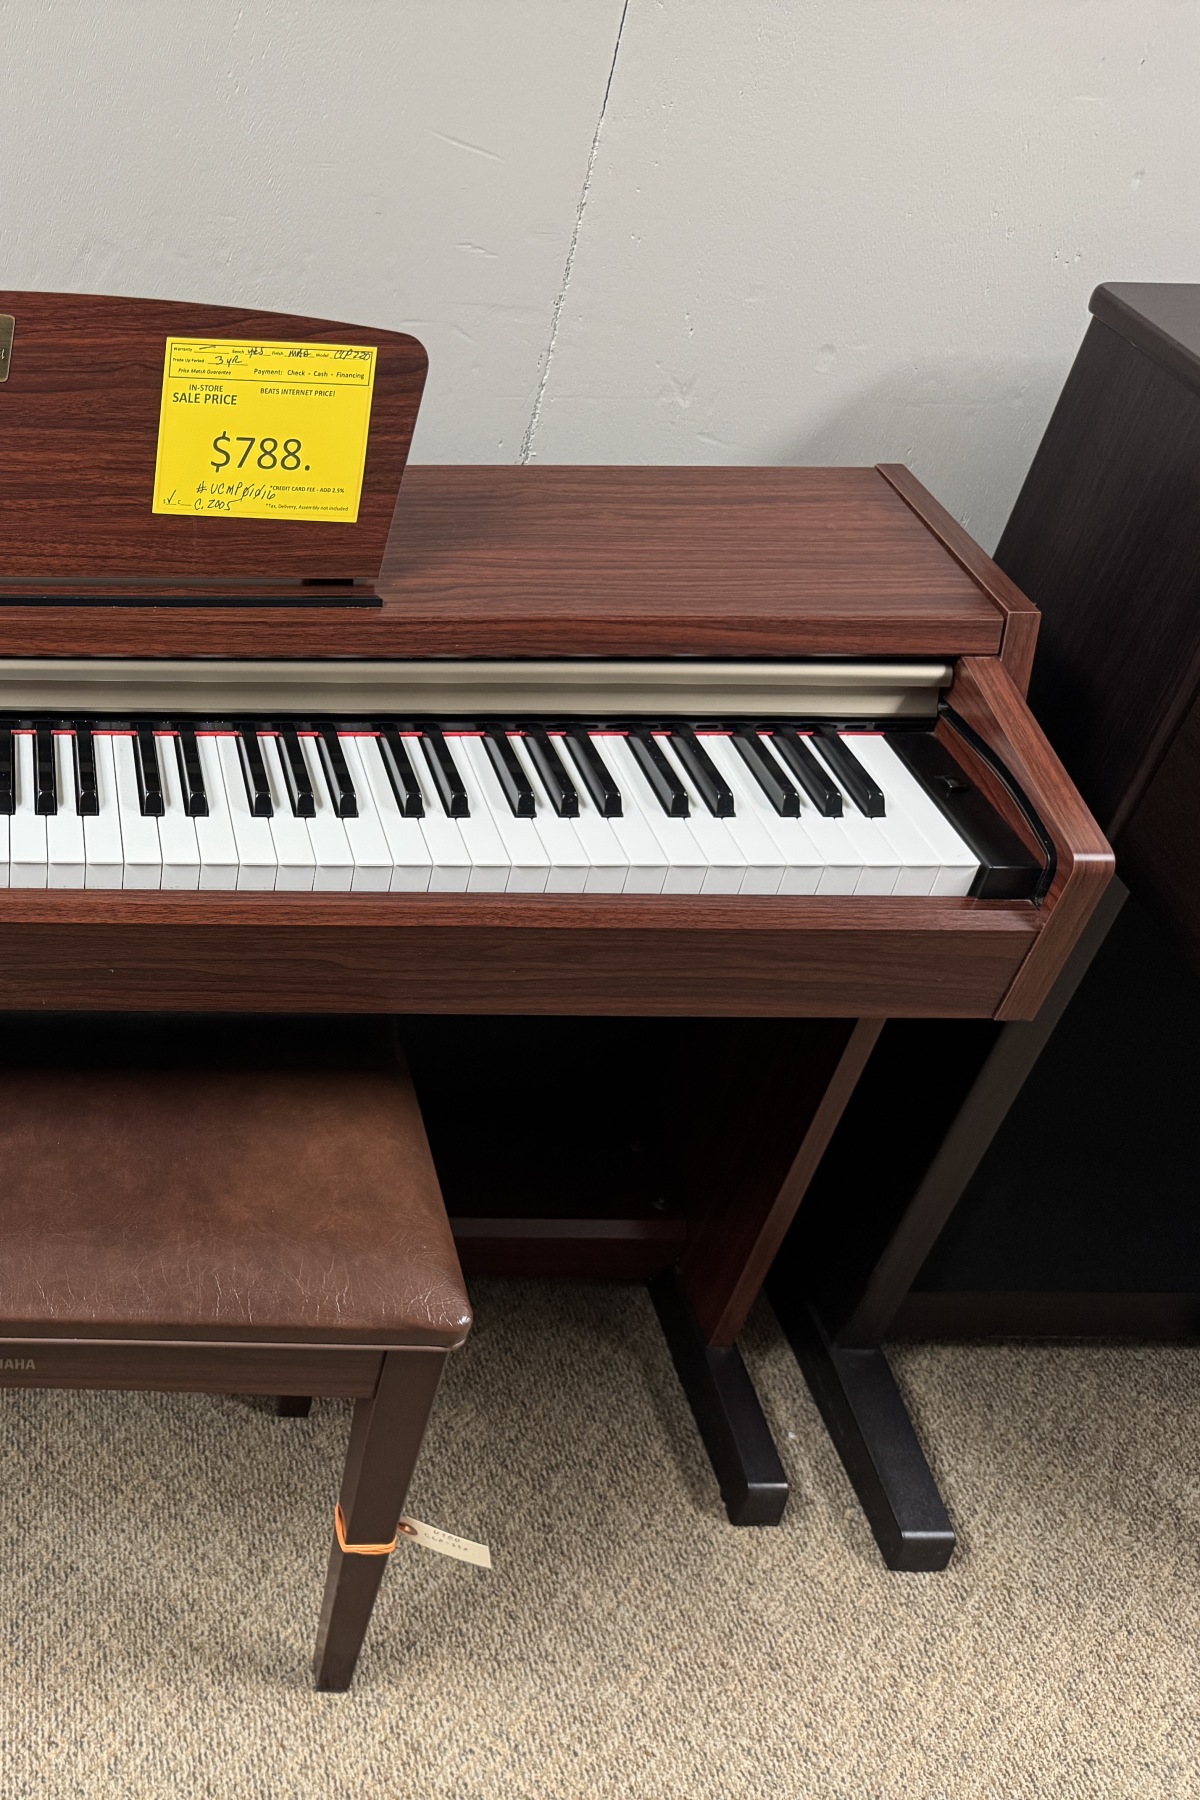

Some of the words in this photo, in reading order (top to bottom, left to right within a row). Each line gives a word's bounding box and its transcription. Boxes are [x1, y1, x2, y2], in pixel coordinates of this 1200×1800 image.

[215, 355, 224, 365] 3
[253, 368, 283, 377] Payment:
[336, 371, 365, 380] Financing
[188, 383, 224, 392] IN-STORE
[260, 387, 280, 395] BEATS
[280, 388, 313, 397] INTERNET
[314, 389, 336, 397] PRICE!
[172, 392, 201, 404] SALE
[204, 392, 238, 406] PRICE
[210, 430, 311, 473] $788.
